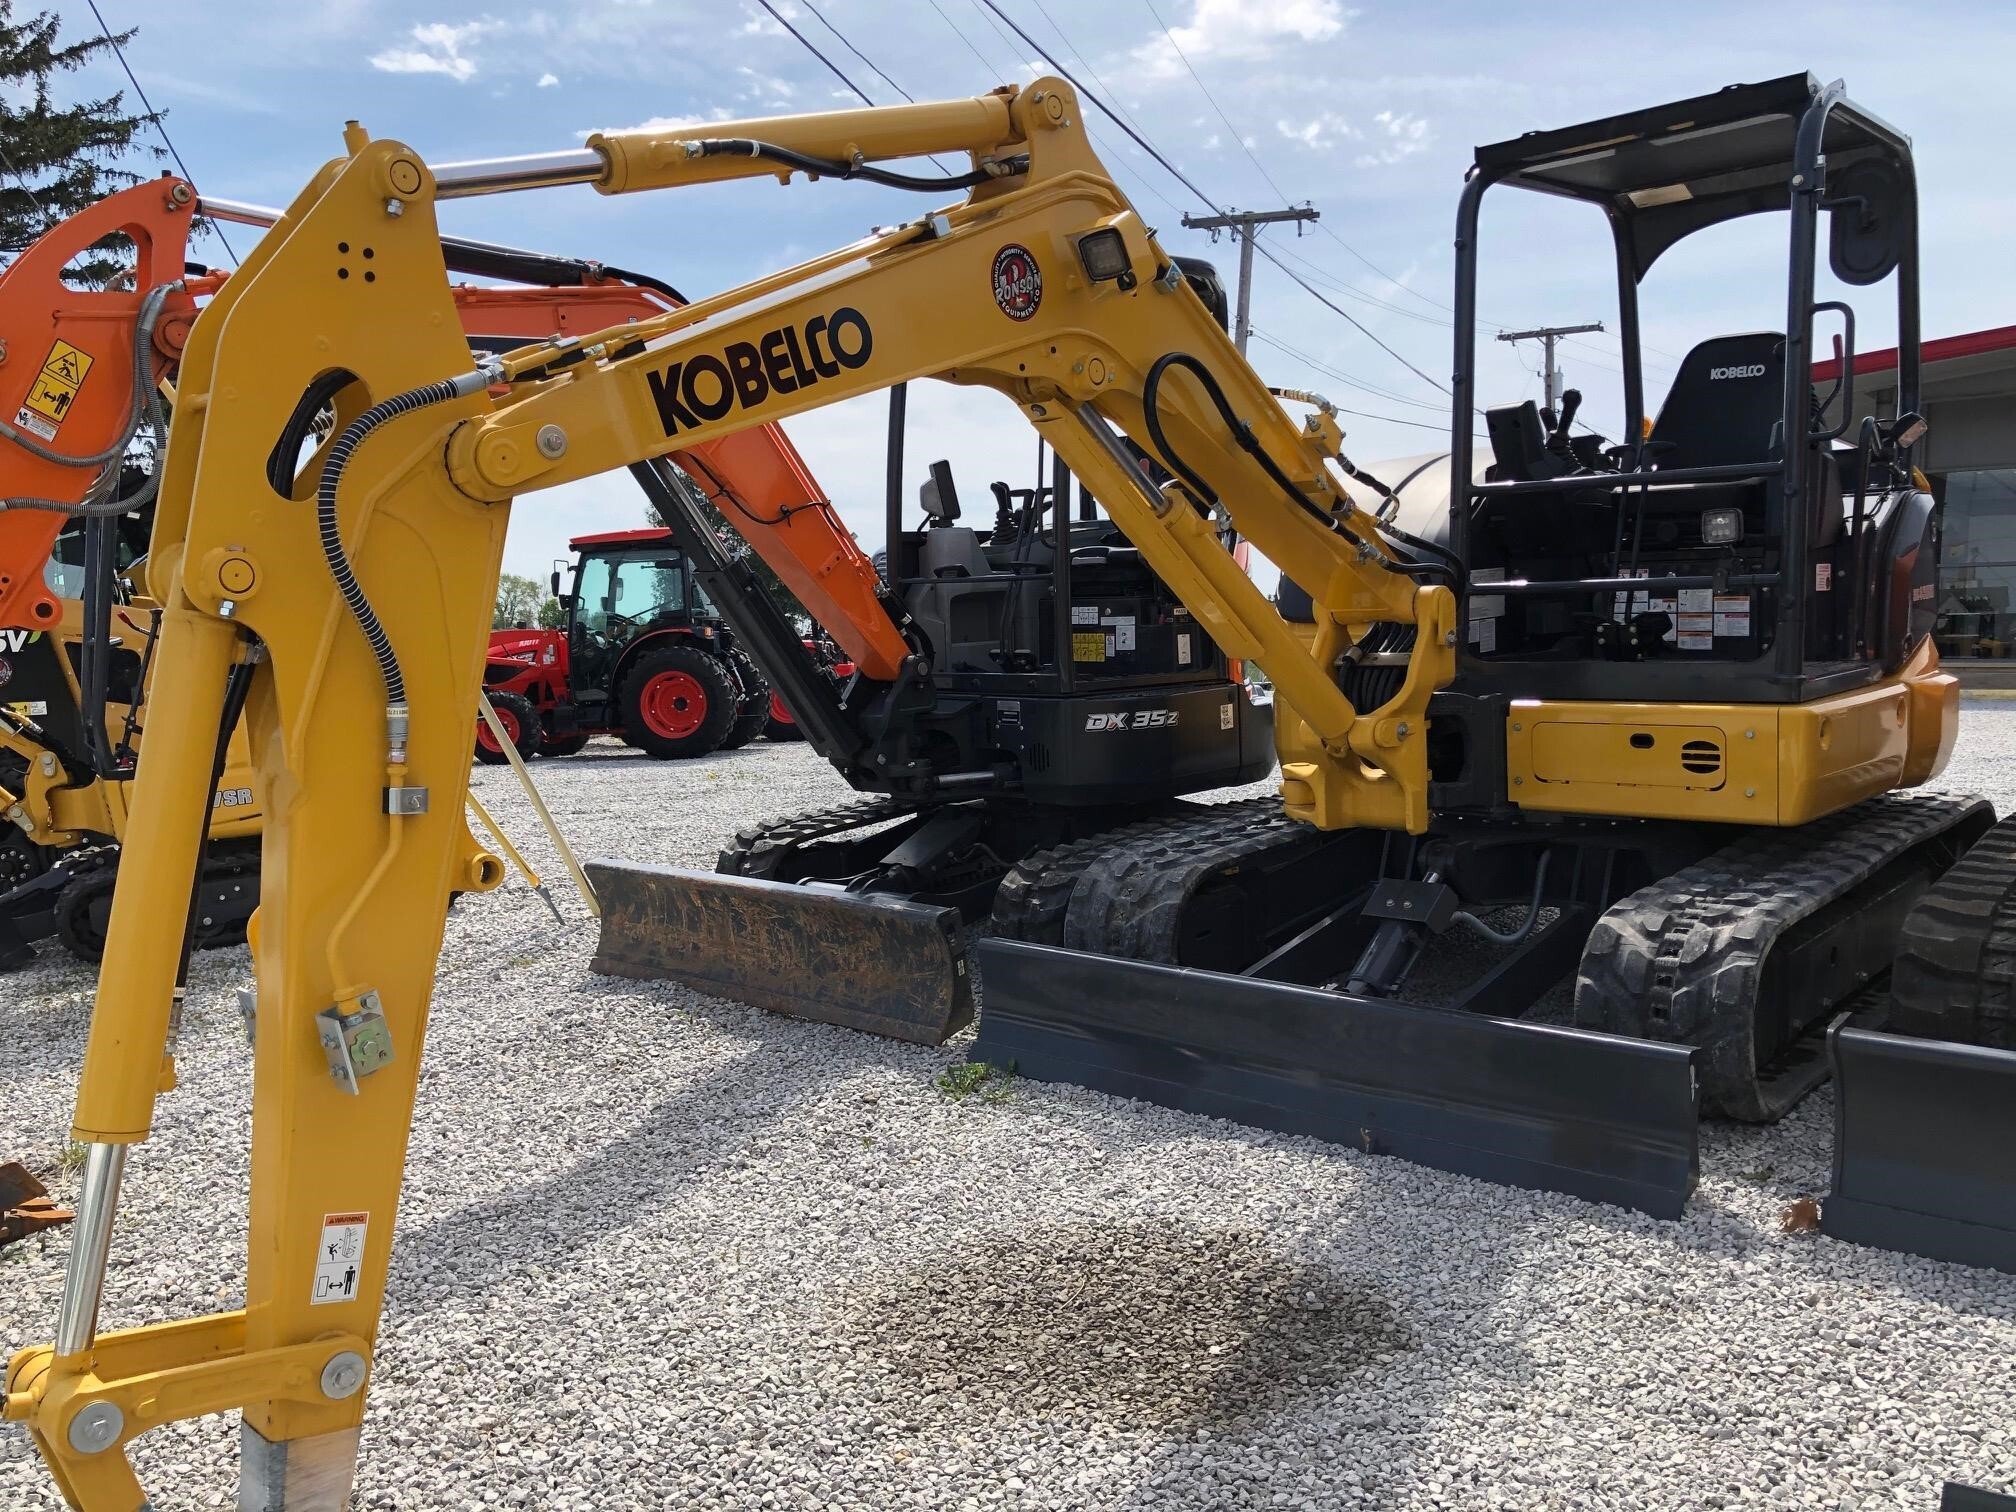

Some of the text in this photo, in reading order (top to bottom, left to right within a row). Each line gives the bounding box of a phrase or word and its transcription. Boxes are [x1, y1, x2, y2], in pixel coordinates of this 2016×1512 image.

[995, 272, 1042, 304] RONSON
[1002, 301, 1036, 318] EQUIPMENT
[646, 307, 873, 437] KOBELCO
[1710, 364, 1765, 380] KOBELCO
[1085, 712, 1128, 732] DX
